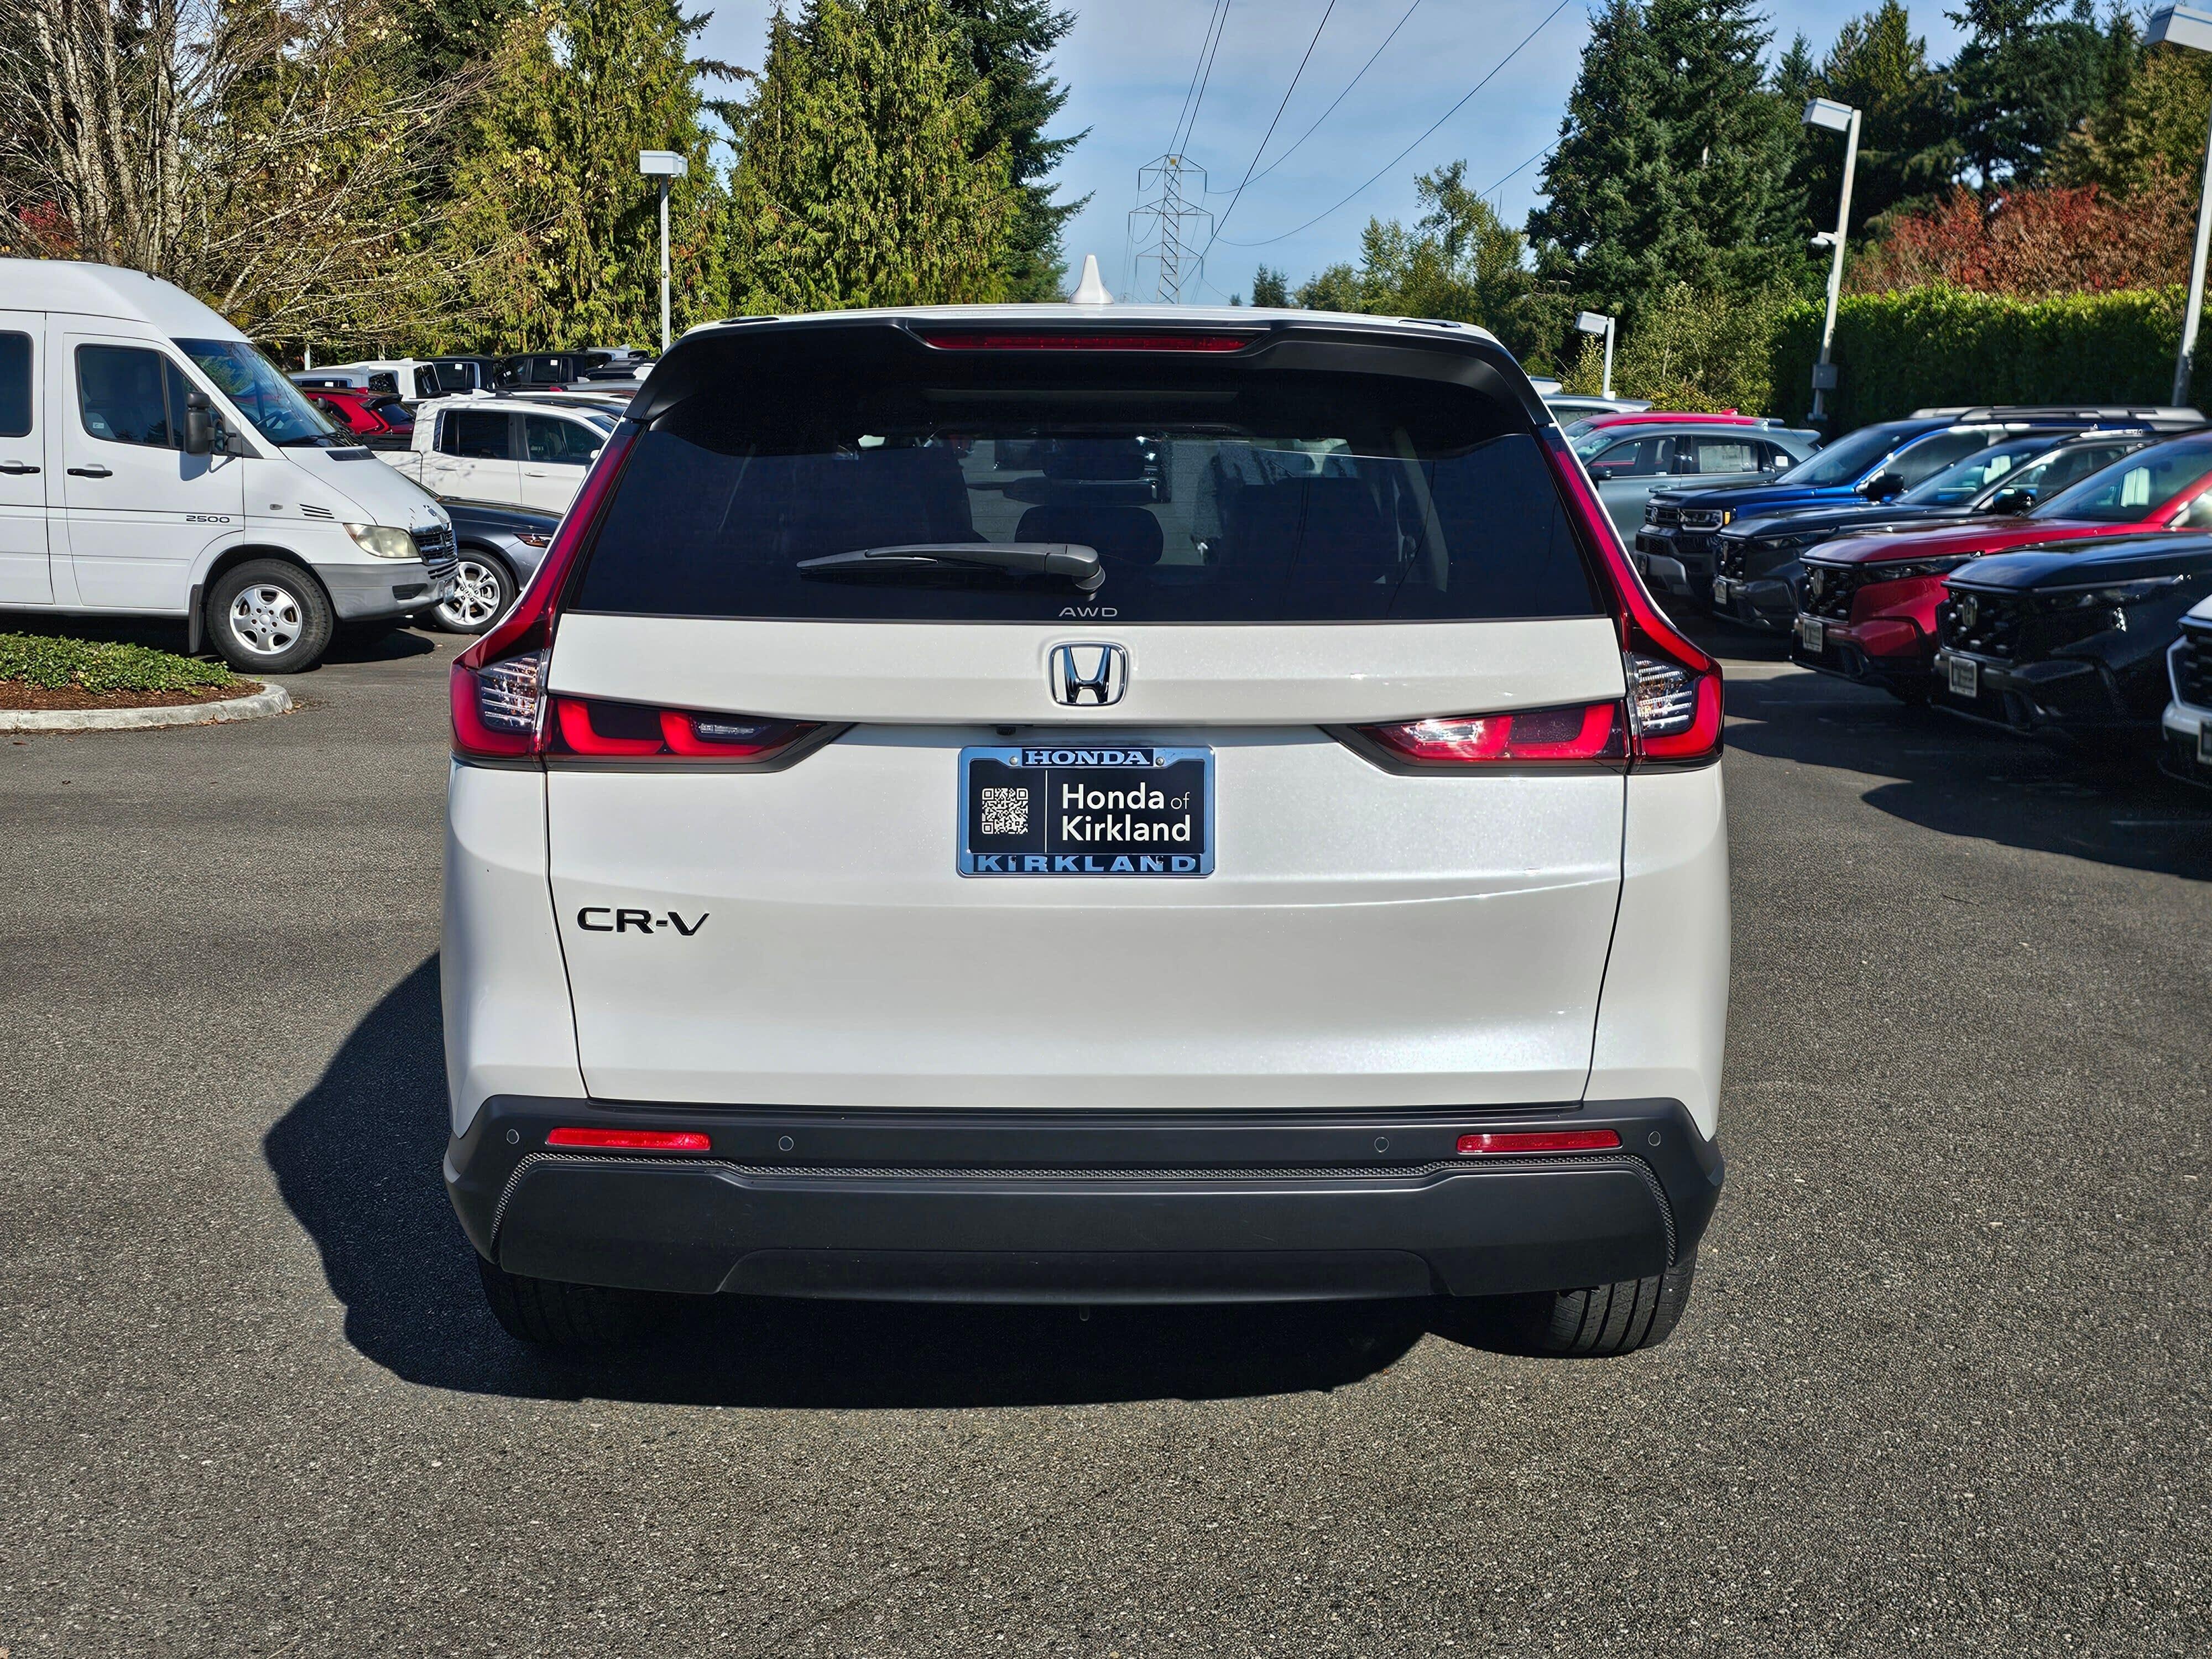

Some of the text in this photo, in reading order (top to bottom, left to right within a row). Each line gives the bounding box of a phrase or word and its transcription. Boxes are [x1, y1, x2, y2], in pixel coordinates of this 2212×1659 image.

[186, 515, 230, 523] 2500
[1058, 607, 1118, 617] AWD
[1025, 750, 1150, 765] HONDA
[1062, 782, 1190, 810] Honda of
[1062, 814, 1191, 841] Kirkland
[977, 854, 1197, 872] KIRKLAND
[577, 907, 710, 936] CR-V
